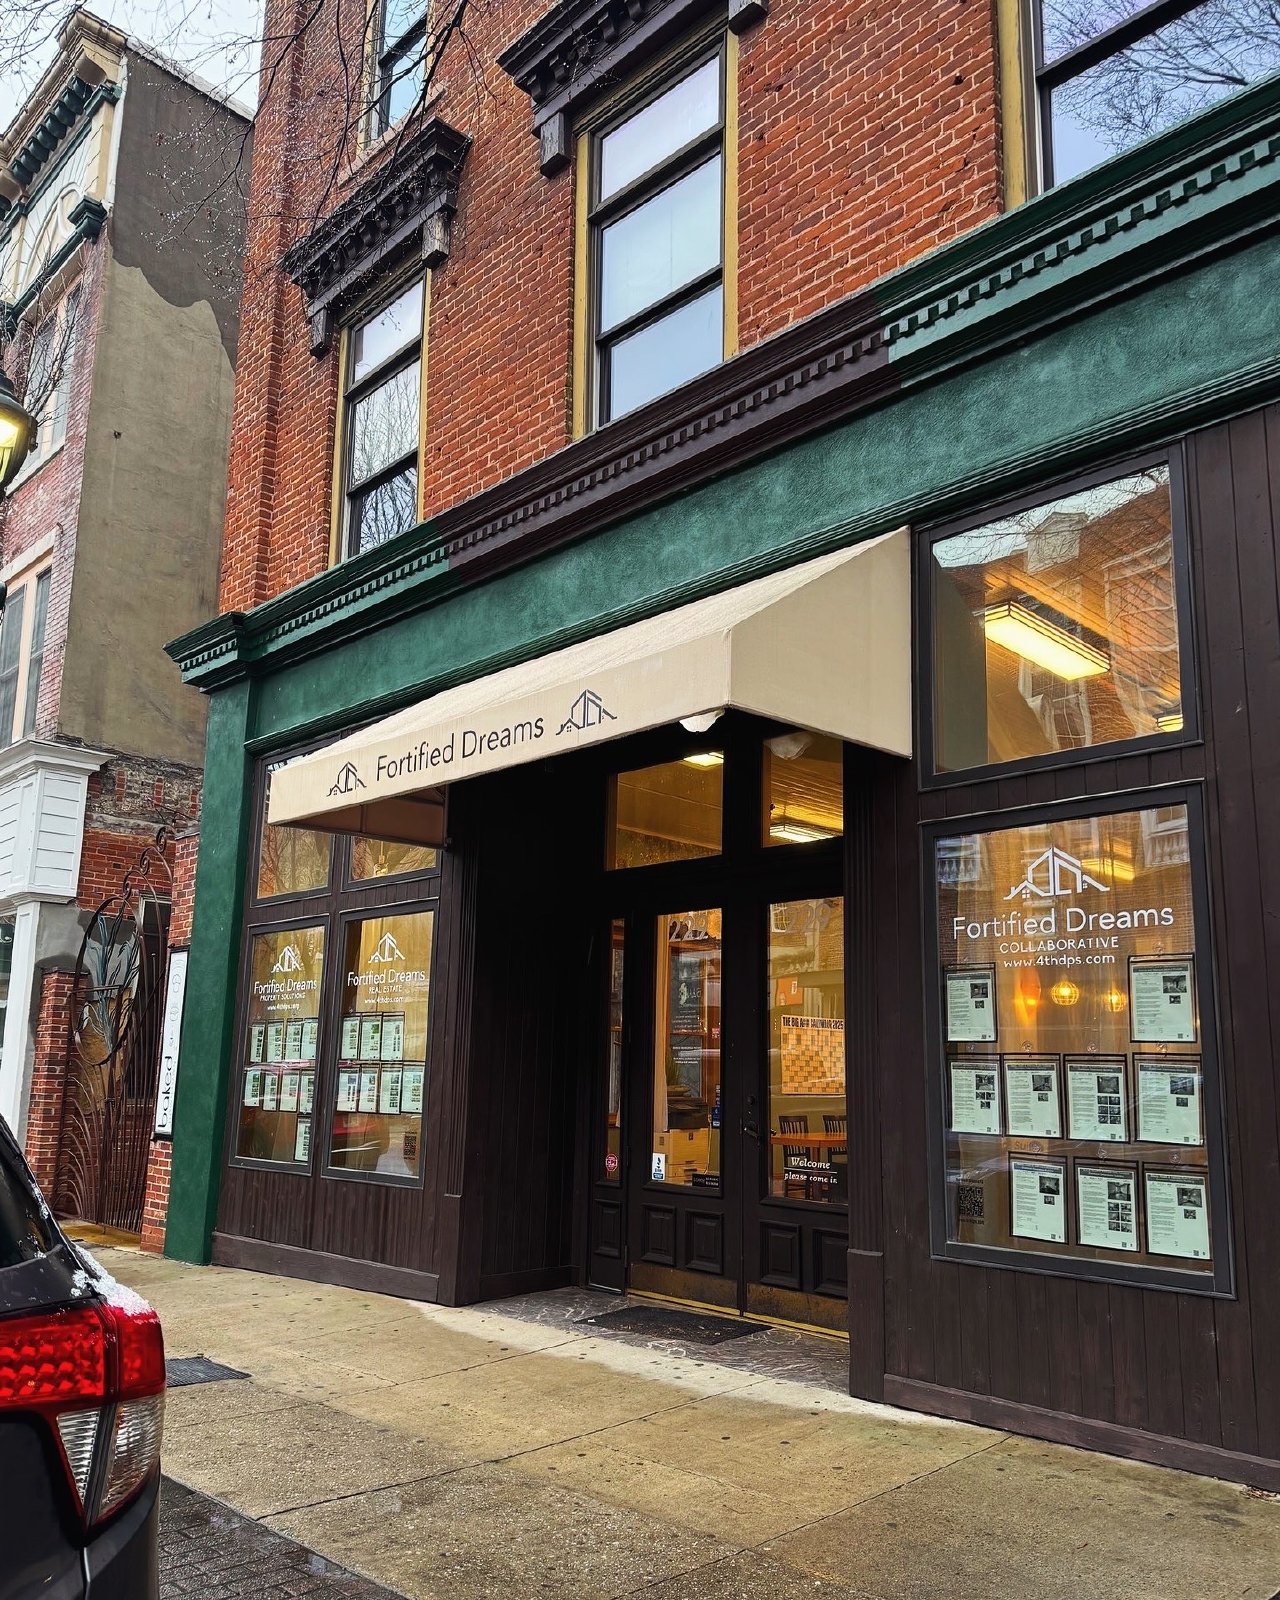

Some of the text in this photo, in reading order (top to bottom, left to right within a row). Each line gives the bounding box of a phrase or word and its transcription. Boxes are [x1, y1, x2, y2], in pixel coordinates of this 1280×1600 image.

[376, 716, 544, 782] Fortified Dreams
[953, 906, 1174, 940] Fortified Dreams
[999, 936, 1120, 954] COLLABORATIVE
[1003, 954, 1116, 969] www.4thdps.com
[347, 968, 426, 987] Fortified Dreams
[253, 978, 318, 995] Fortified Dreams
[368, 984, 403, 994] REAL ESTATE
[157, 1056, 173, 1128] baked
[790, 1156, 831, 1170] Welcome
[784, 1171, 808, 1181] please
[809, 1175, 829, 1183] come
